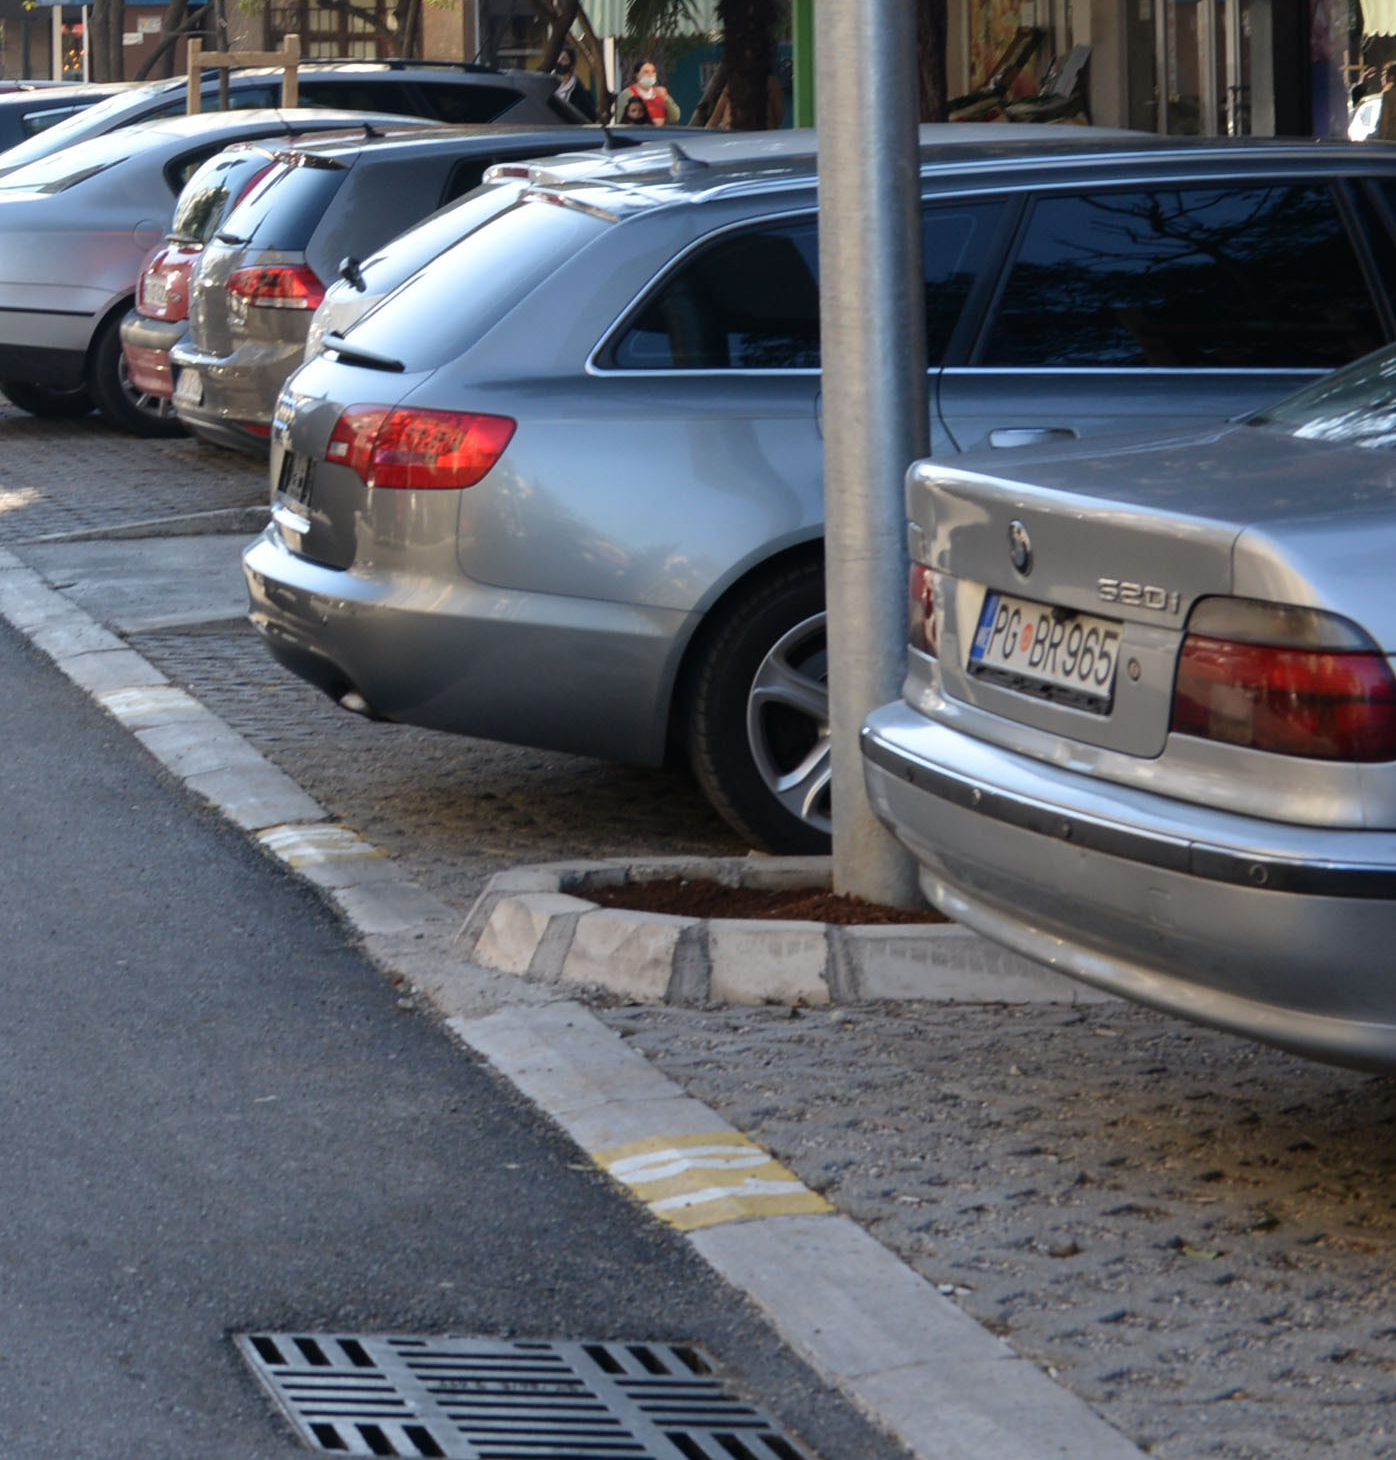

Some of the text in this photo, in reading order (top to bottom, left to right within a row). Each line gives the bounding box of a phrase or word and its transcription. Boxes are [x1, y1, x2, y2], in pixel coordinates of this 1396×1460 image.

[1097, 577, 1182, 615] 520i
[986, 603, 1120, 687] PG BR965
